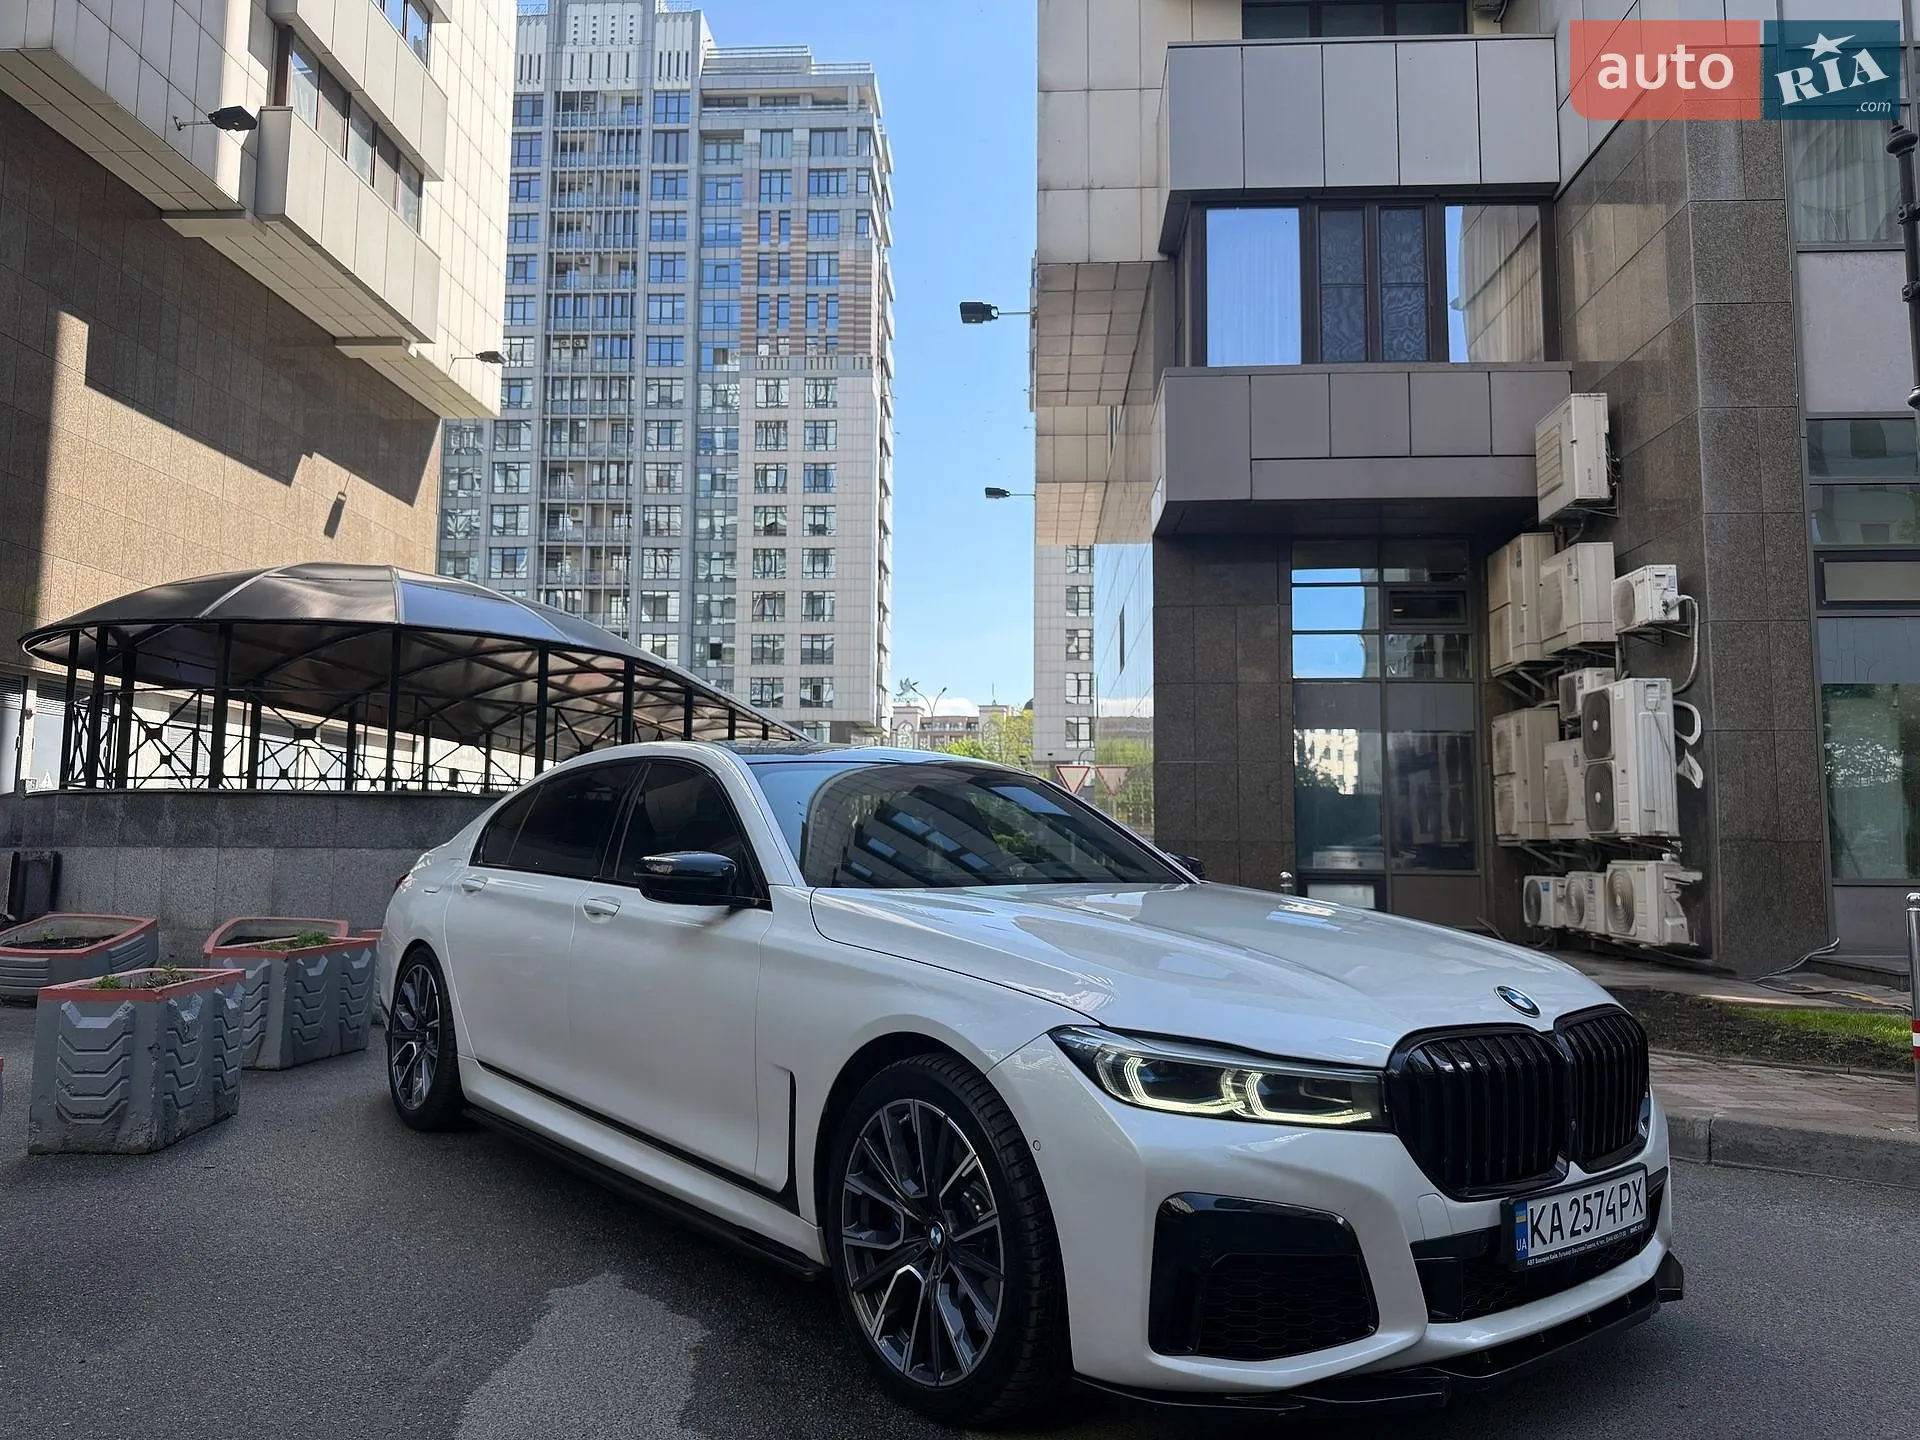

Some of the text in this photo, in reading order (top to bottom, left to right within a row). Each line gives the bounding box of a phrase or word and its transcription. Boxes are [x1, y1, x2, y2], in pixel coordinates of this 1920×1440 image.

[1529, 1177, 1643, 1248] KA 2574 PX
[1516, 1238, 1528, 1251] UA
